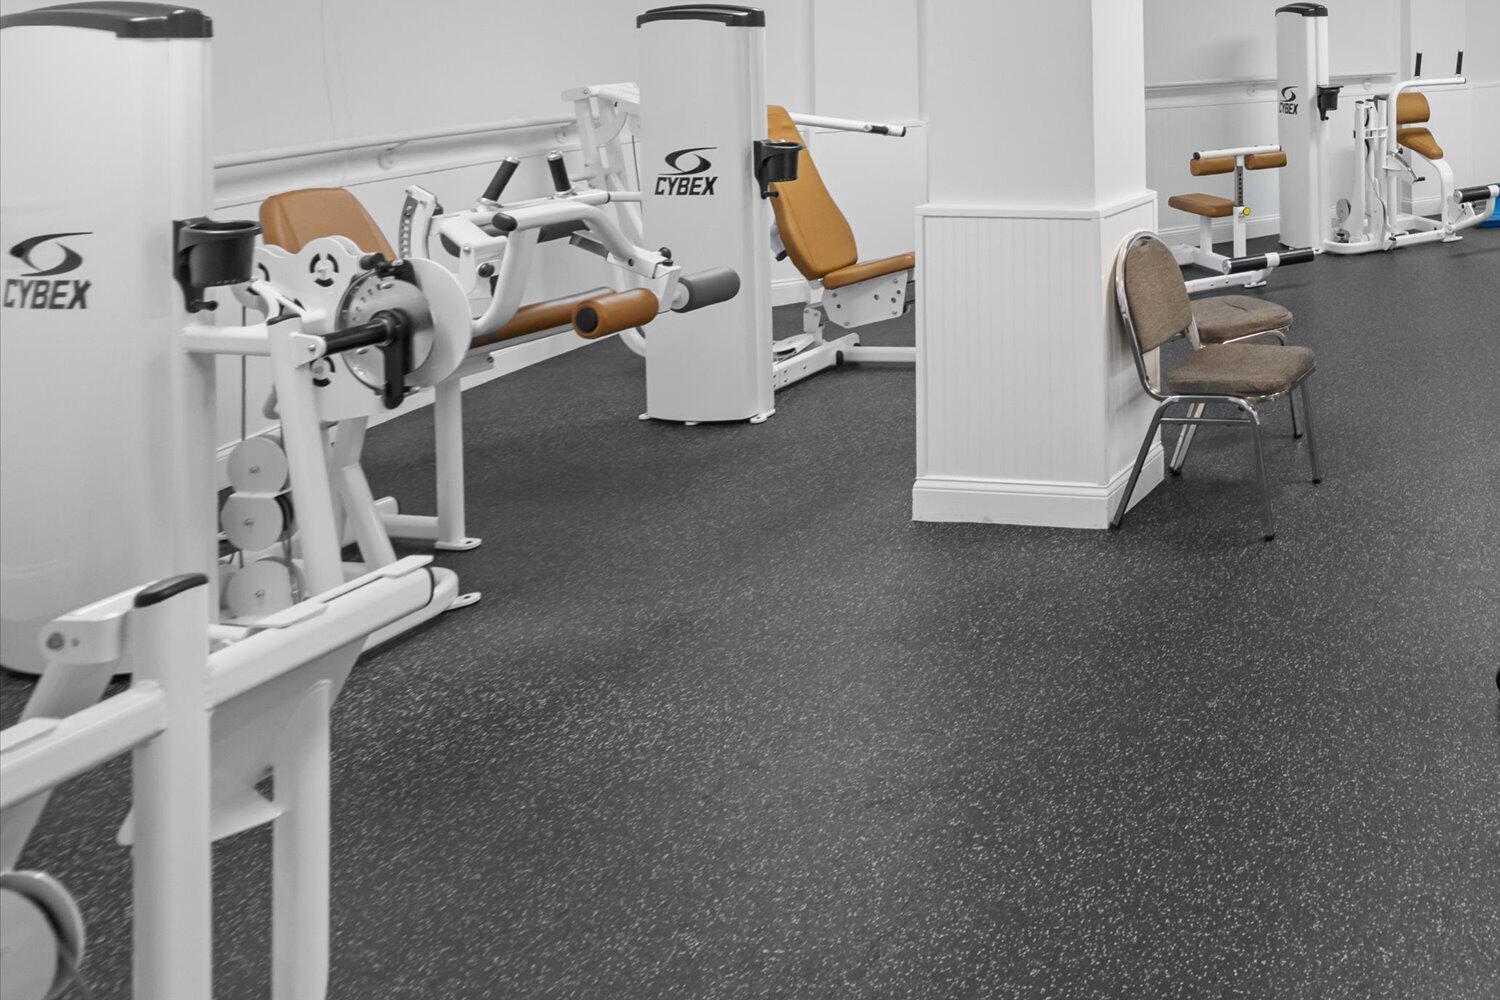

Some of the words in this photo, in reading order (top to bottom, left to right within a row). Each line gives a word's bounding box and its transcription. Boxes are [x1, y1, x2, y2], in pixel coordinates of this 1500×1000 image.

[1279, 101, 1299, 115] CYBEX
[654, 176, 718, 196] CYBEX
[3, 278, 92, 309] CYBEX
